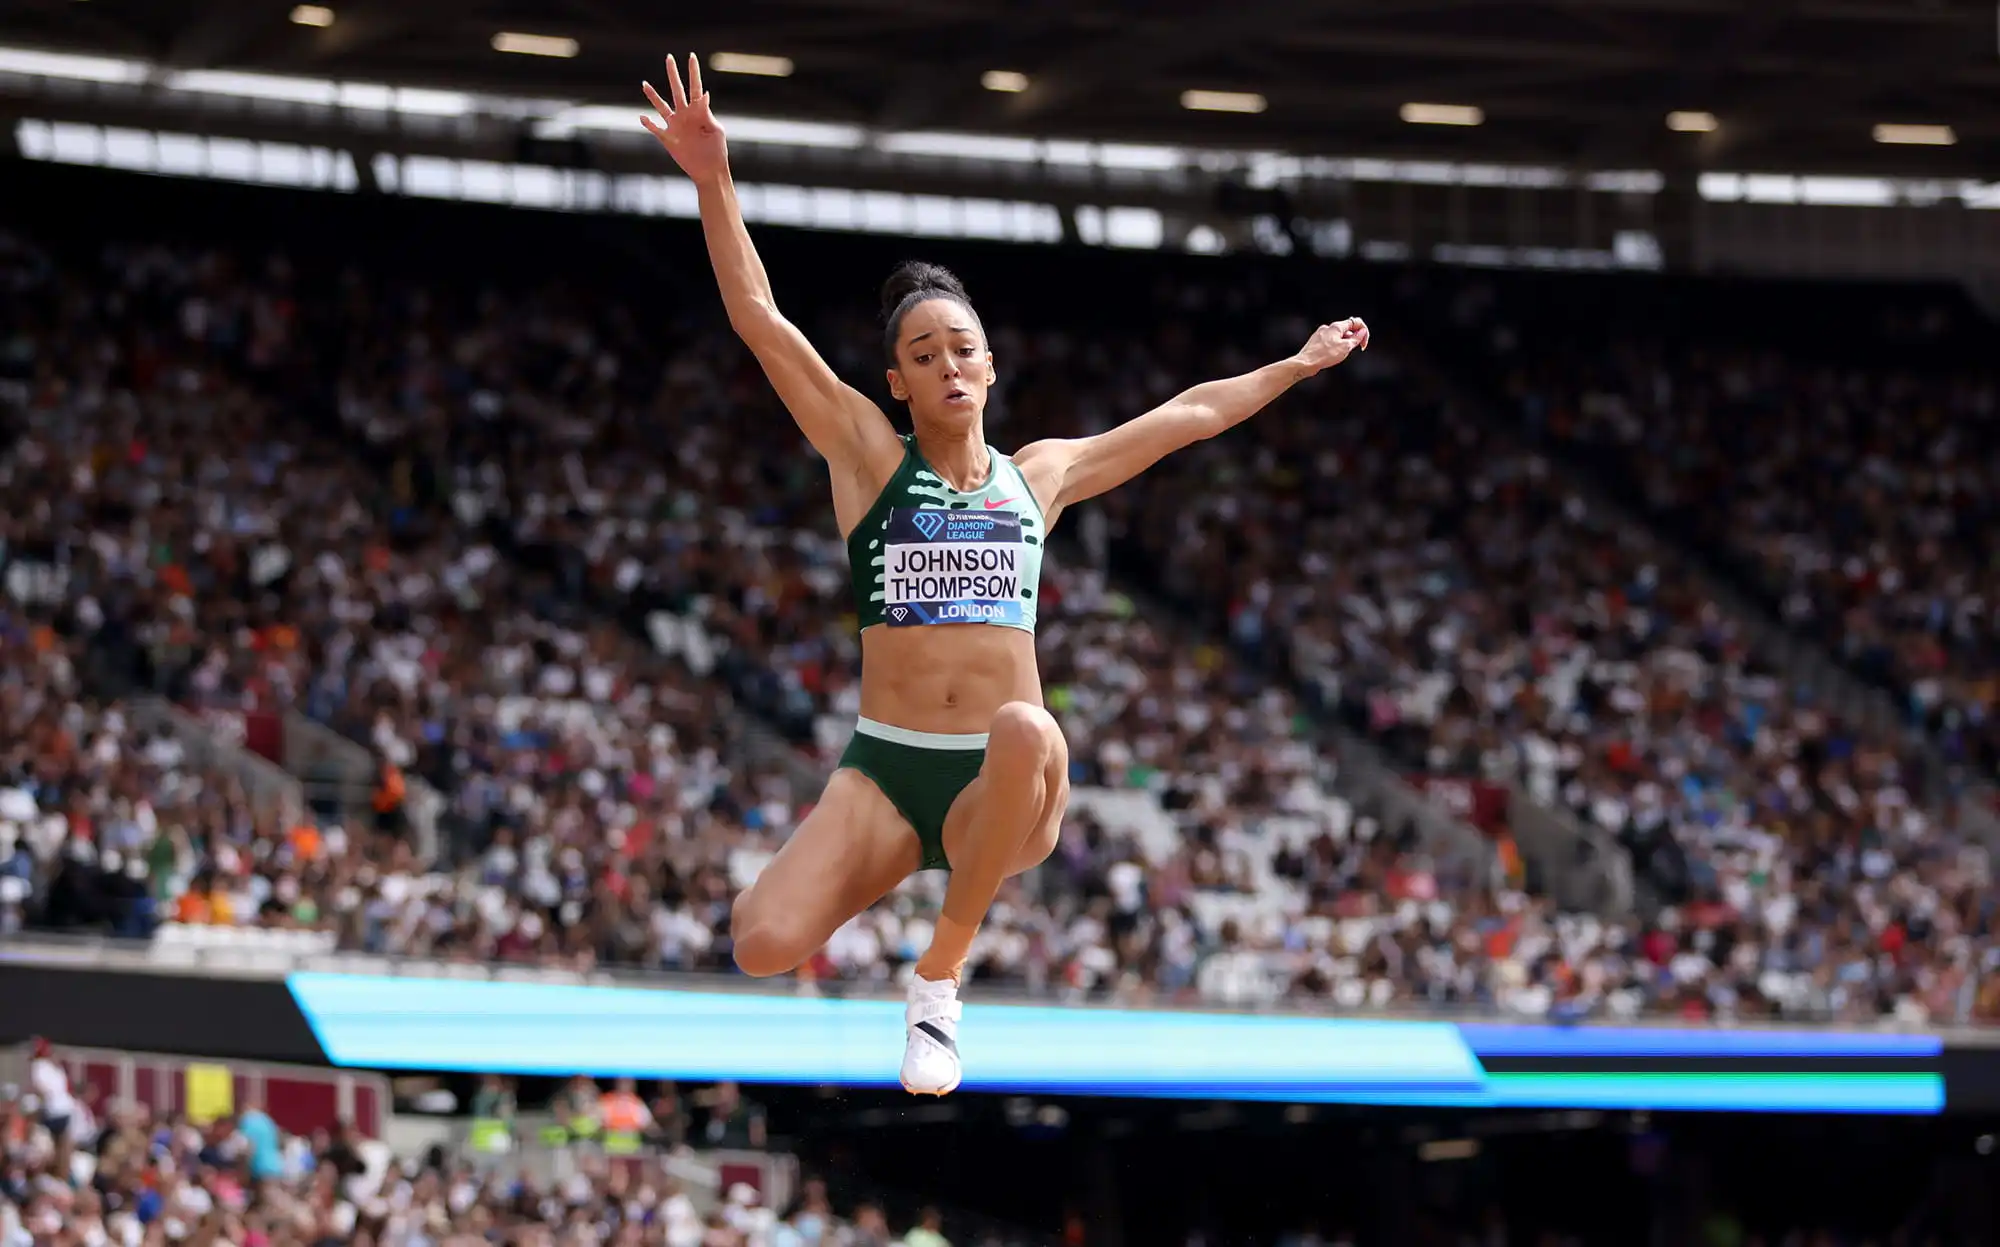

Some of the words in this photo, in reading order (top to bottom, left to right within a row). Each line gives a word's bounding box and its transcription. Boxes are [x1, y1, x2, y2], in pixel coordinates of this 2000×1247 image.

[947, 521, 994, 530] DIAMOND
[946, 531, 985, 539] LEAGUE
[894, 549, 1015, 573] JOHNSON
[891, 576, 1017, 600] THOMPSON
[938, 604, 1005, 618] LONDON
